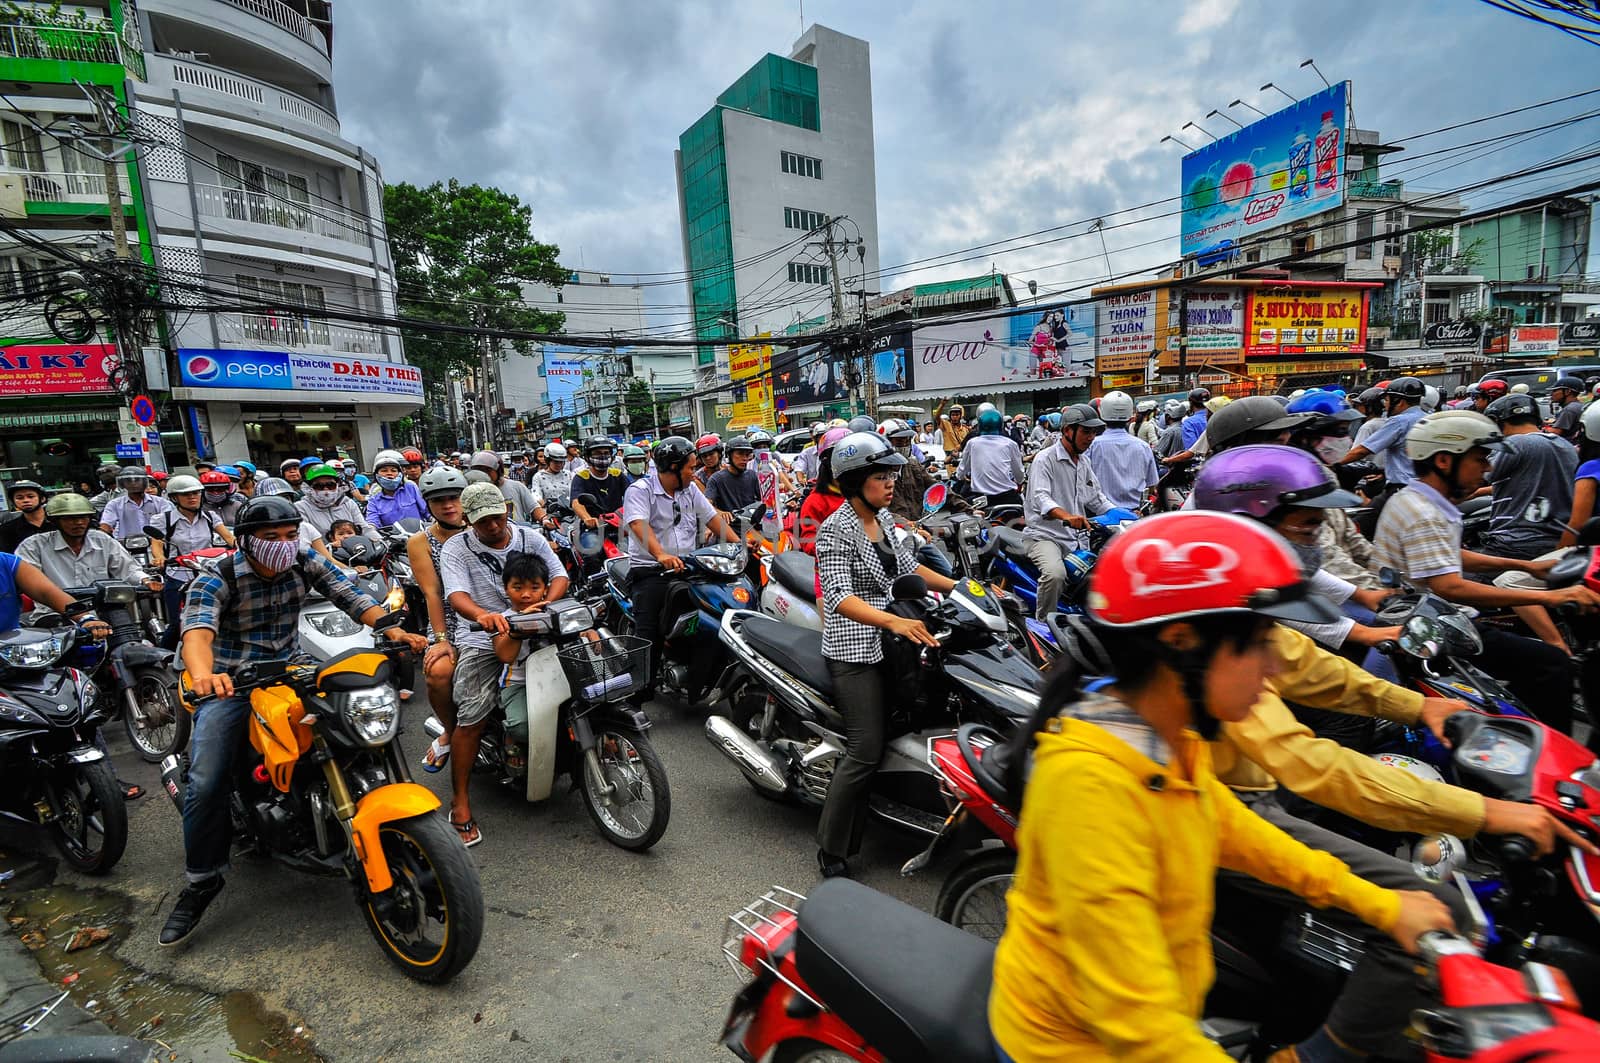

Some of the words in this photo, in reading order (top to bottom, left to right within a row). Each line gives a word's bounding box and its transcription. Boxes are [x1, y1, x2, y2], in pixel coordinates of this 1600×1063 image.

[1109, 306, 1147, 321] THANH
[1266, 298, 1324, 318] HUỲNH
[1327, 298, 1349, 318] KÝ
[1111, 320, 1143, 335] XUÂN
[922, 340, 988, 364] wow
[226, 362, 288, 378] pepsi
[291, 359, 311, 369] TIỆM
[312, 360, 331, 369] CƠM
[332, 361, 380, 377] DÂN
